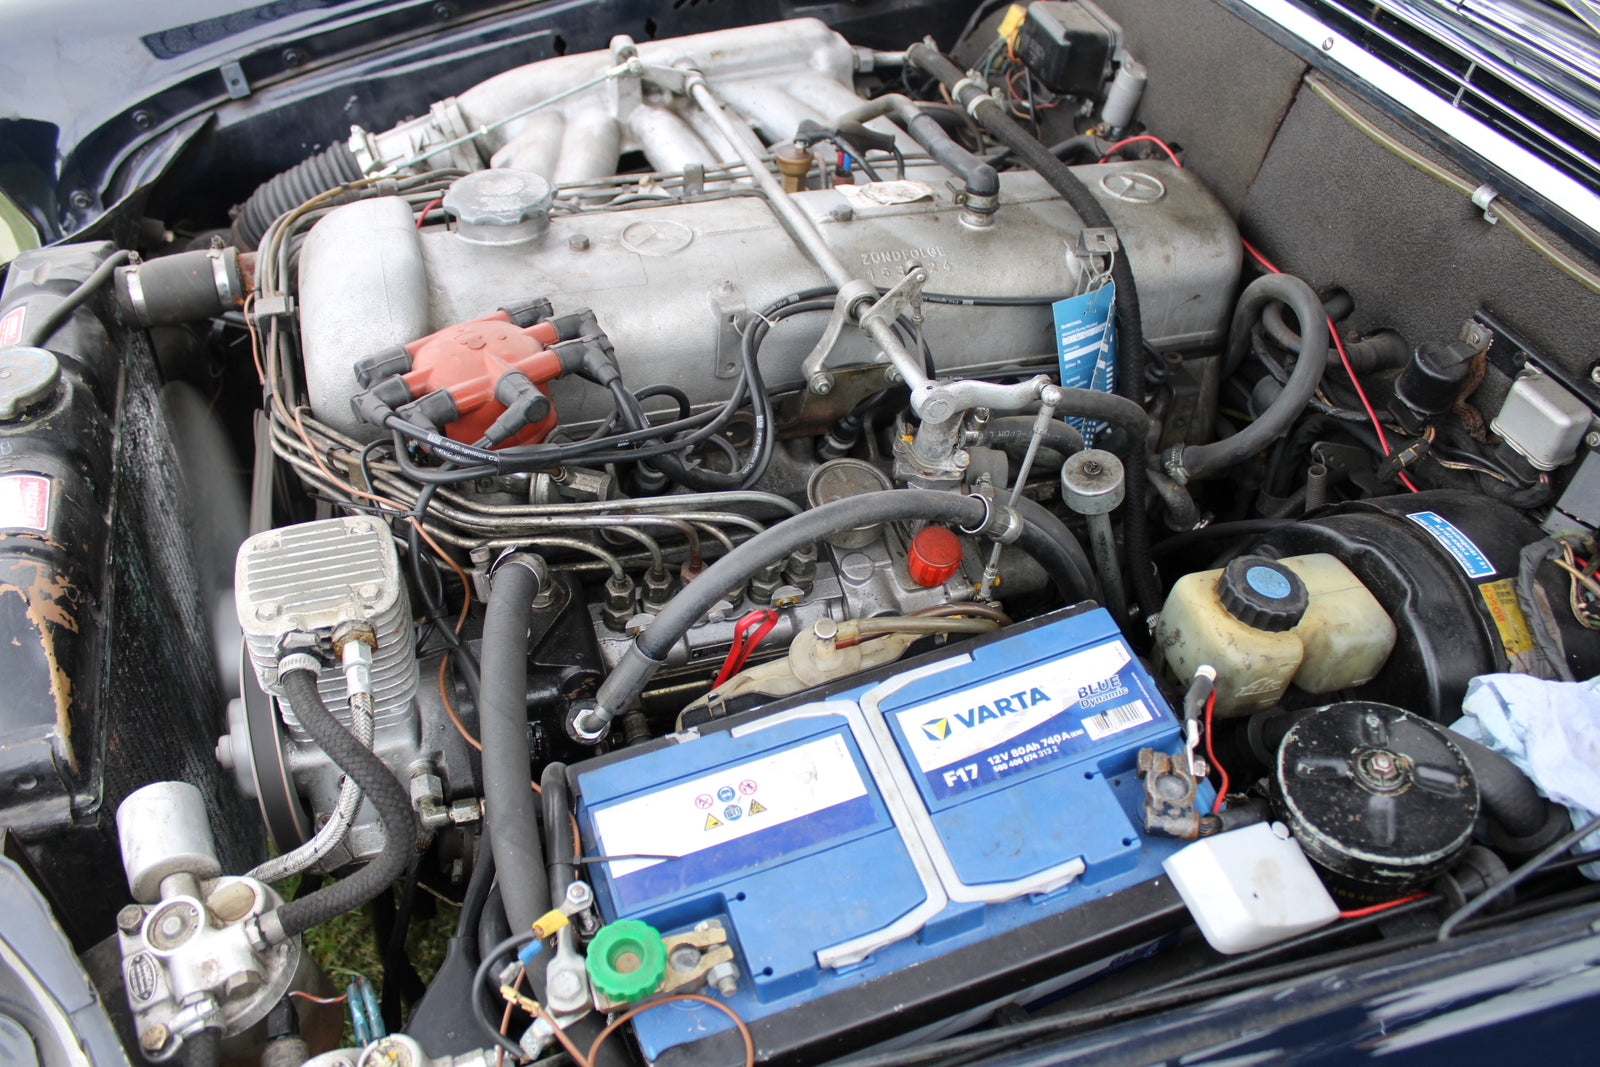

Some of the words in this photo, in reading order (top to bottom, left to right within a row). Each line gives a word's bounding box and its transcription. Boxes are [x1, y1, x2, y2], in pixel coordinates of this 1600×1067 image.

[461, 447, 488, 460] Ignition
[1480, 585, 1506, 622] BOSCH
[1077, 674, 1122, 699] BLUE
[1080, 686, 1129, 710] Dynamic
[953, 687, 1052, 729] VARTA
[986, 752, 1009, 767] 12V
[1010, 741, 1041, 759] 80Ah
[943, 763, 979, 788] F17
